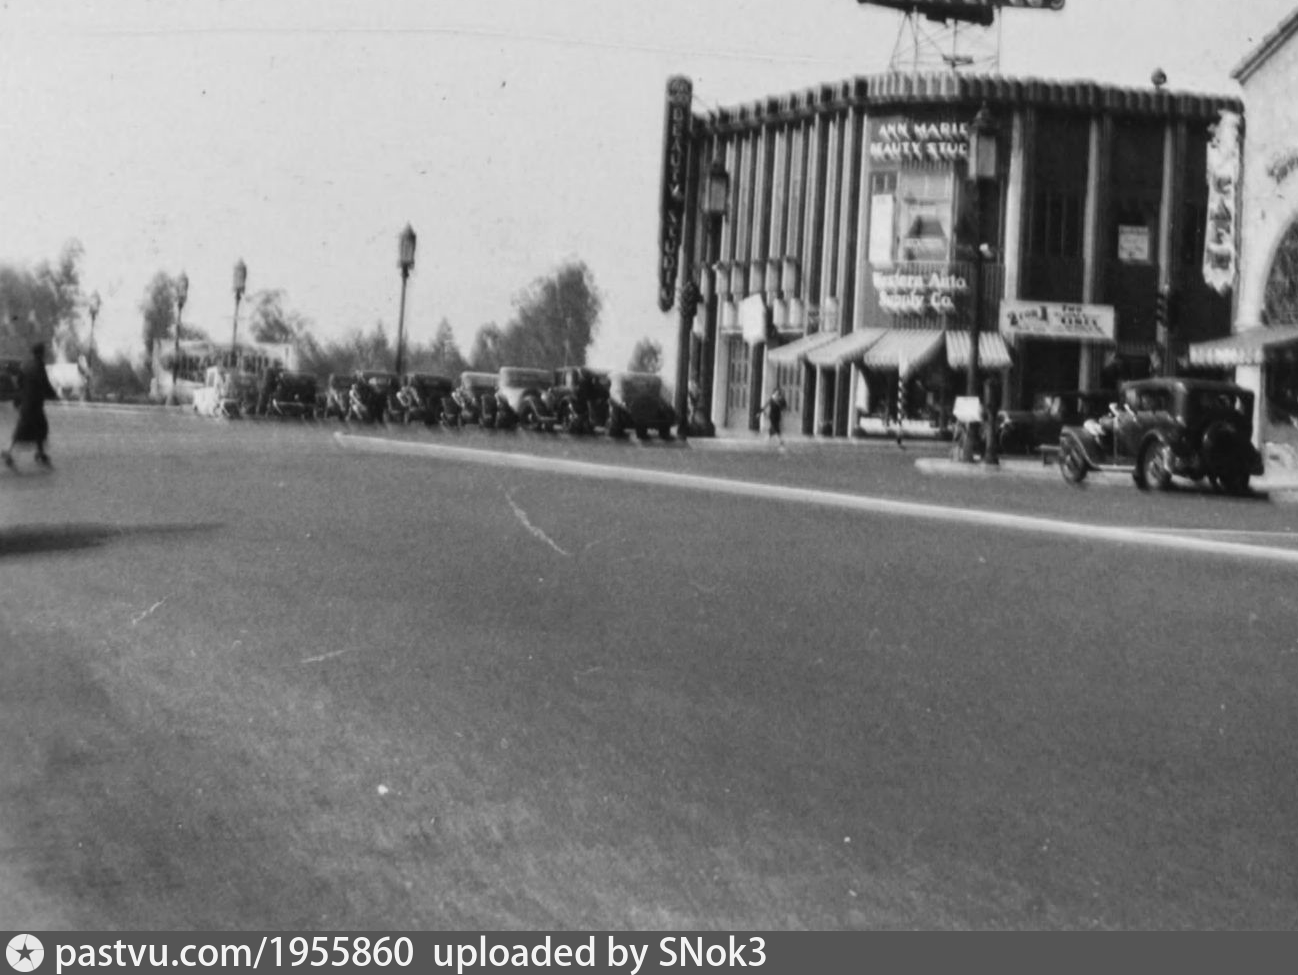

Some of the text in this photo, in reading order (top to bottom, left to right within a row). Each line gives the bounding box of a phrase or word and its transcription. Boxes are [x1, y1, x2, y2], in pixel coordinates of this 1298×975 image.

[870, 142, 969, 161] BEAUTY STUD
[929, 273, 968, 291] Auto
